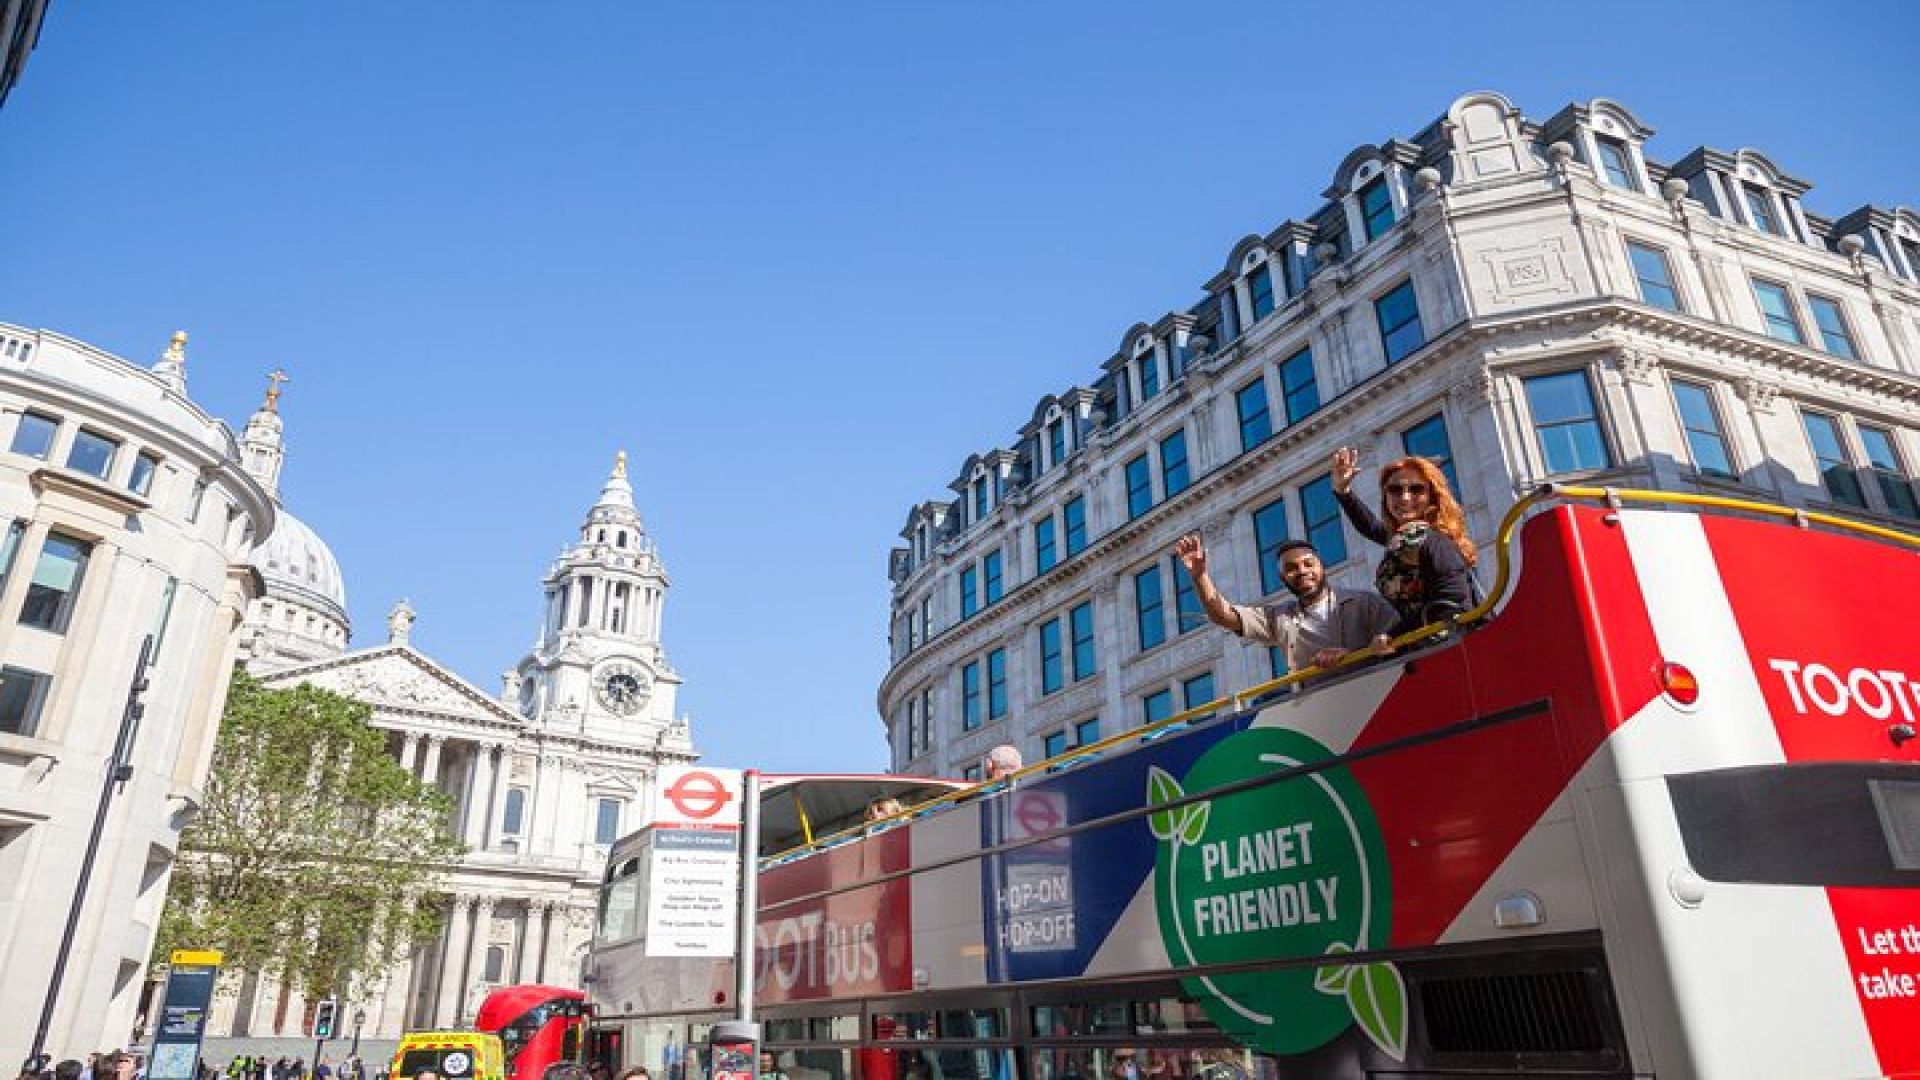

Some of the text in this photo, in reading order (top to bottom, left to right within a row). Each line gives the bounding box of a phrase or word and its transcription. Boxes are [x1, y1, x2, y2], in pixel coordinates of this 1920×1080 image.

[1202, 821, 1313, 882] PLANET
[997, 876, 1067, 916] HOP-ON
[1194, 876, 1338, 937] FRIENDLY
[998, 913, 1075, 949] HOP-OFF
[1858, 926, 1900, 954] Let
[1859, 966, 1916, 999] take
